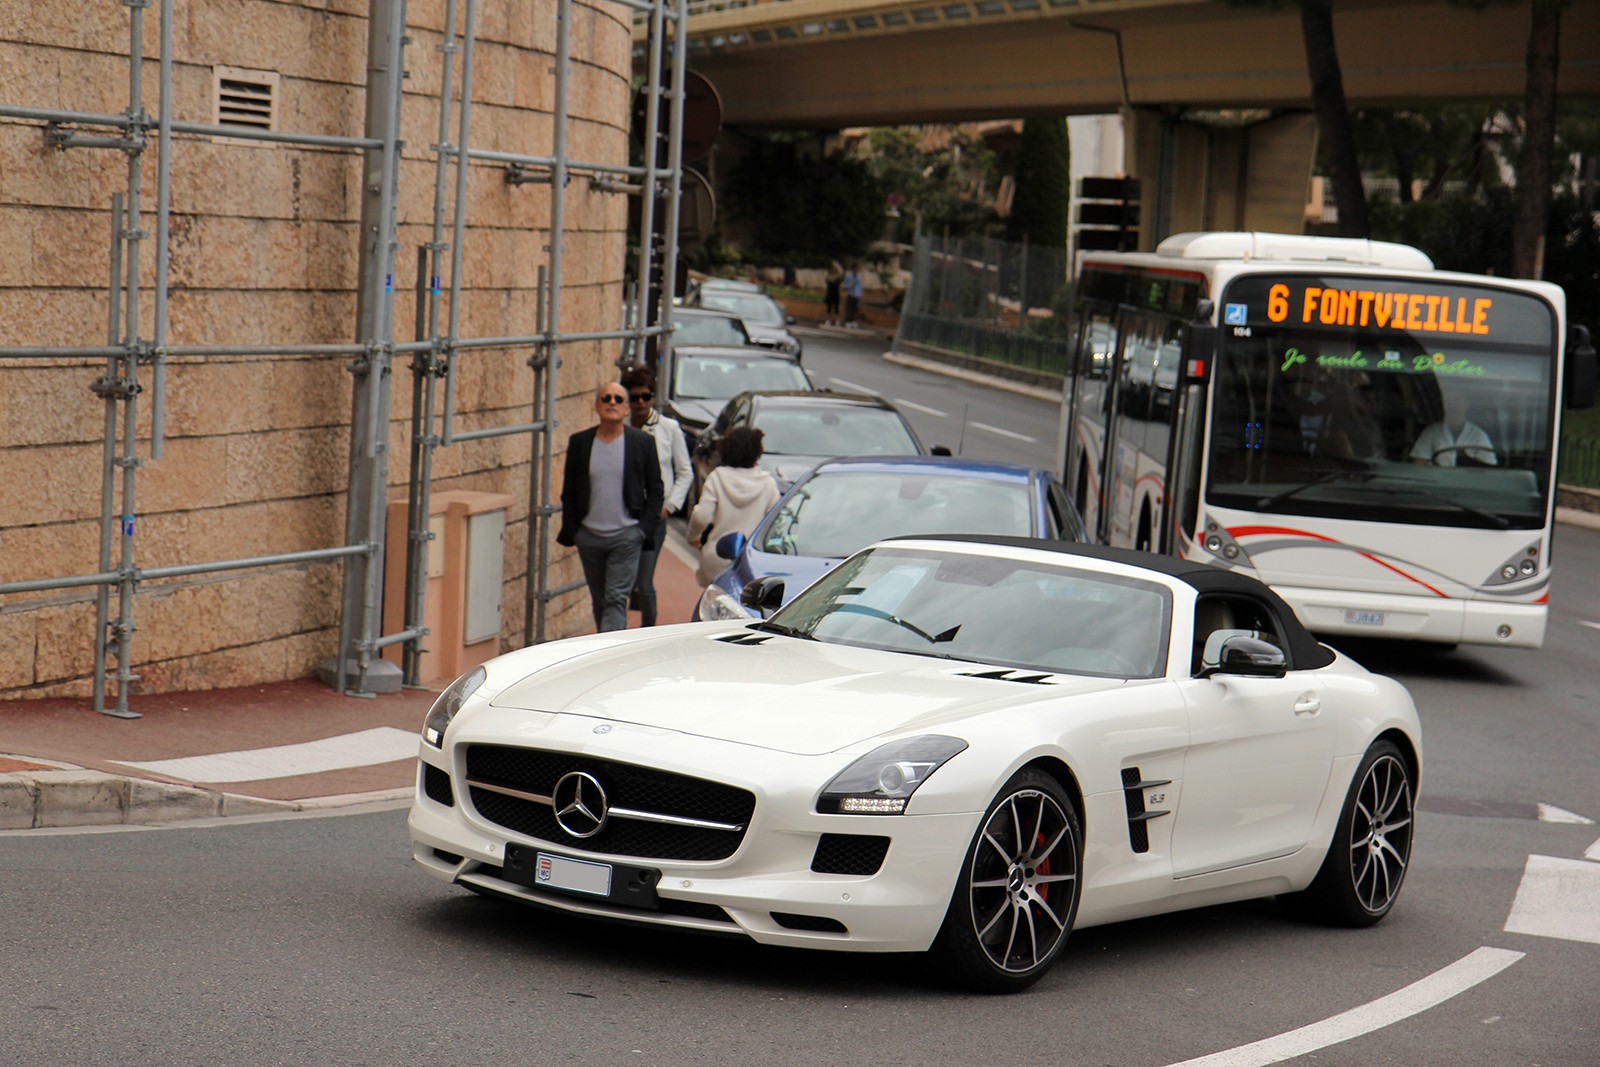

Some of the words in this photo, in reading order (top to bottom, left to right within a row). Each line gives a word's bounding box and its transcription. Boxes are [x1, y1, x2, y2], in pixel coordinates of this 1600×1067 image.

[1267, 284, 1289, 322] 6
[1302, 287, 1492, 335] FONTVIEILLE
[1281, 348, 1308, 373] Je
[1316, 350, 1370, 369] roule
